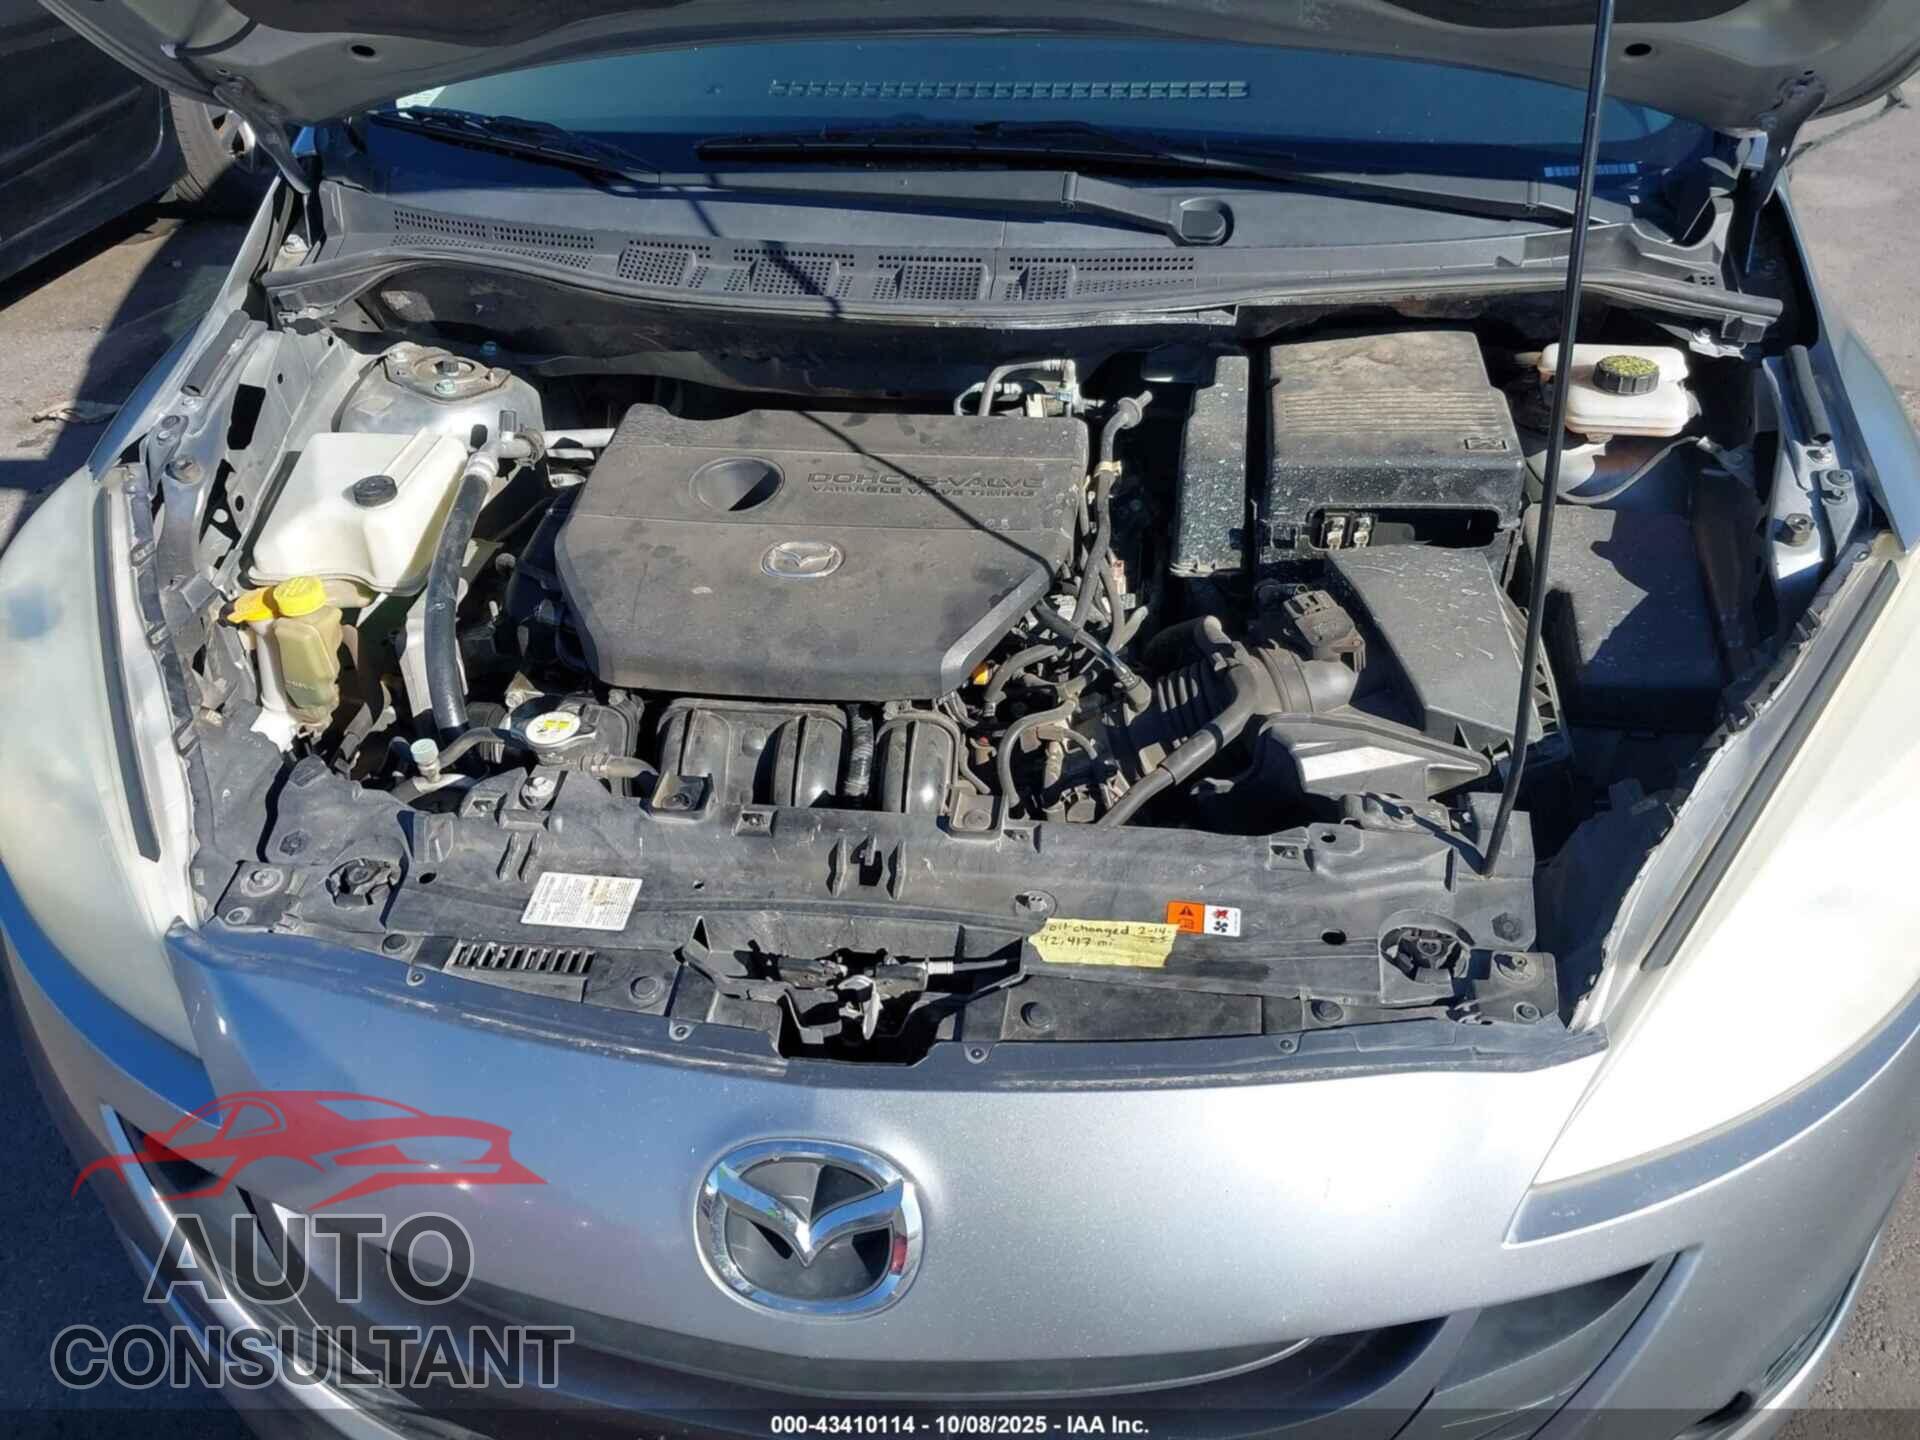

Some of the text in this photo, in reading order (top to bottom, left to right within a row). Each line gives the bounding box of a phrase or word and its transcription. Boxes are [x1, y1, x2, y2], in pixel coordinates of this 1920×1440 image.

[808, 473, 904, 484] DOHC
[812, 486, 1036, 497] VARIABLE VAVE TIMING
[1073, 924, 1130, 938] changed
